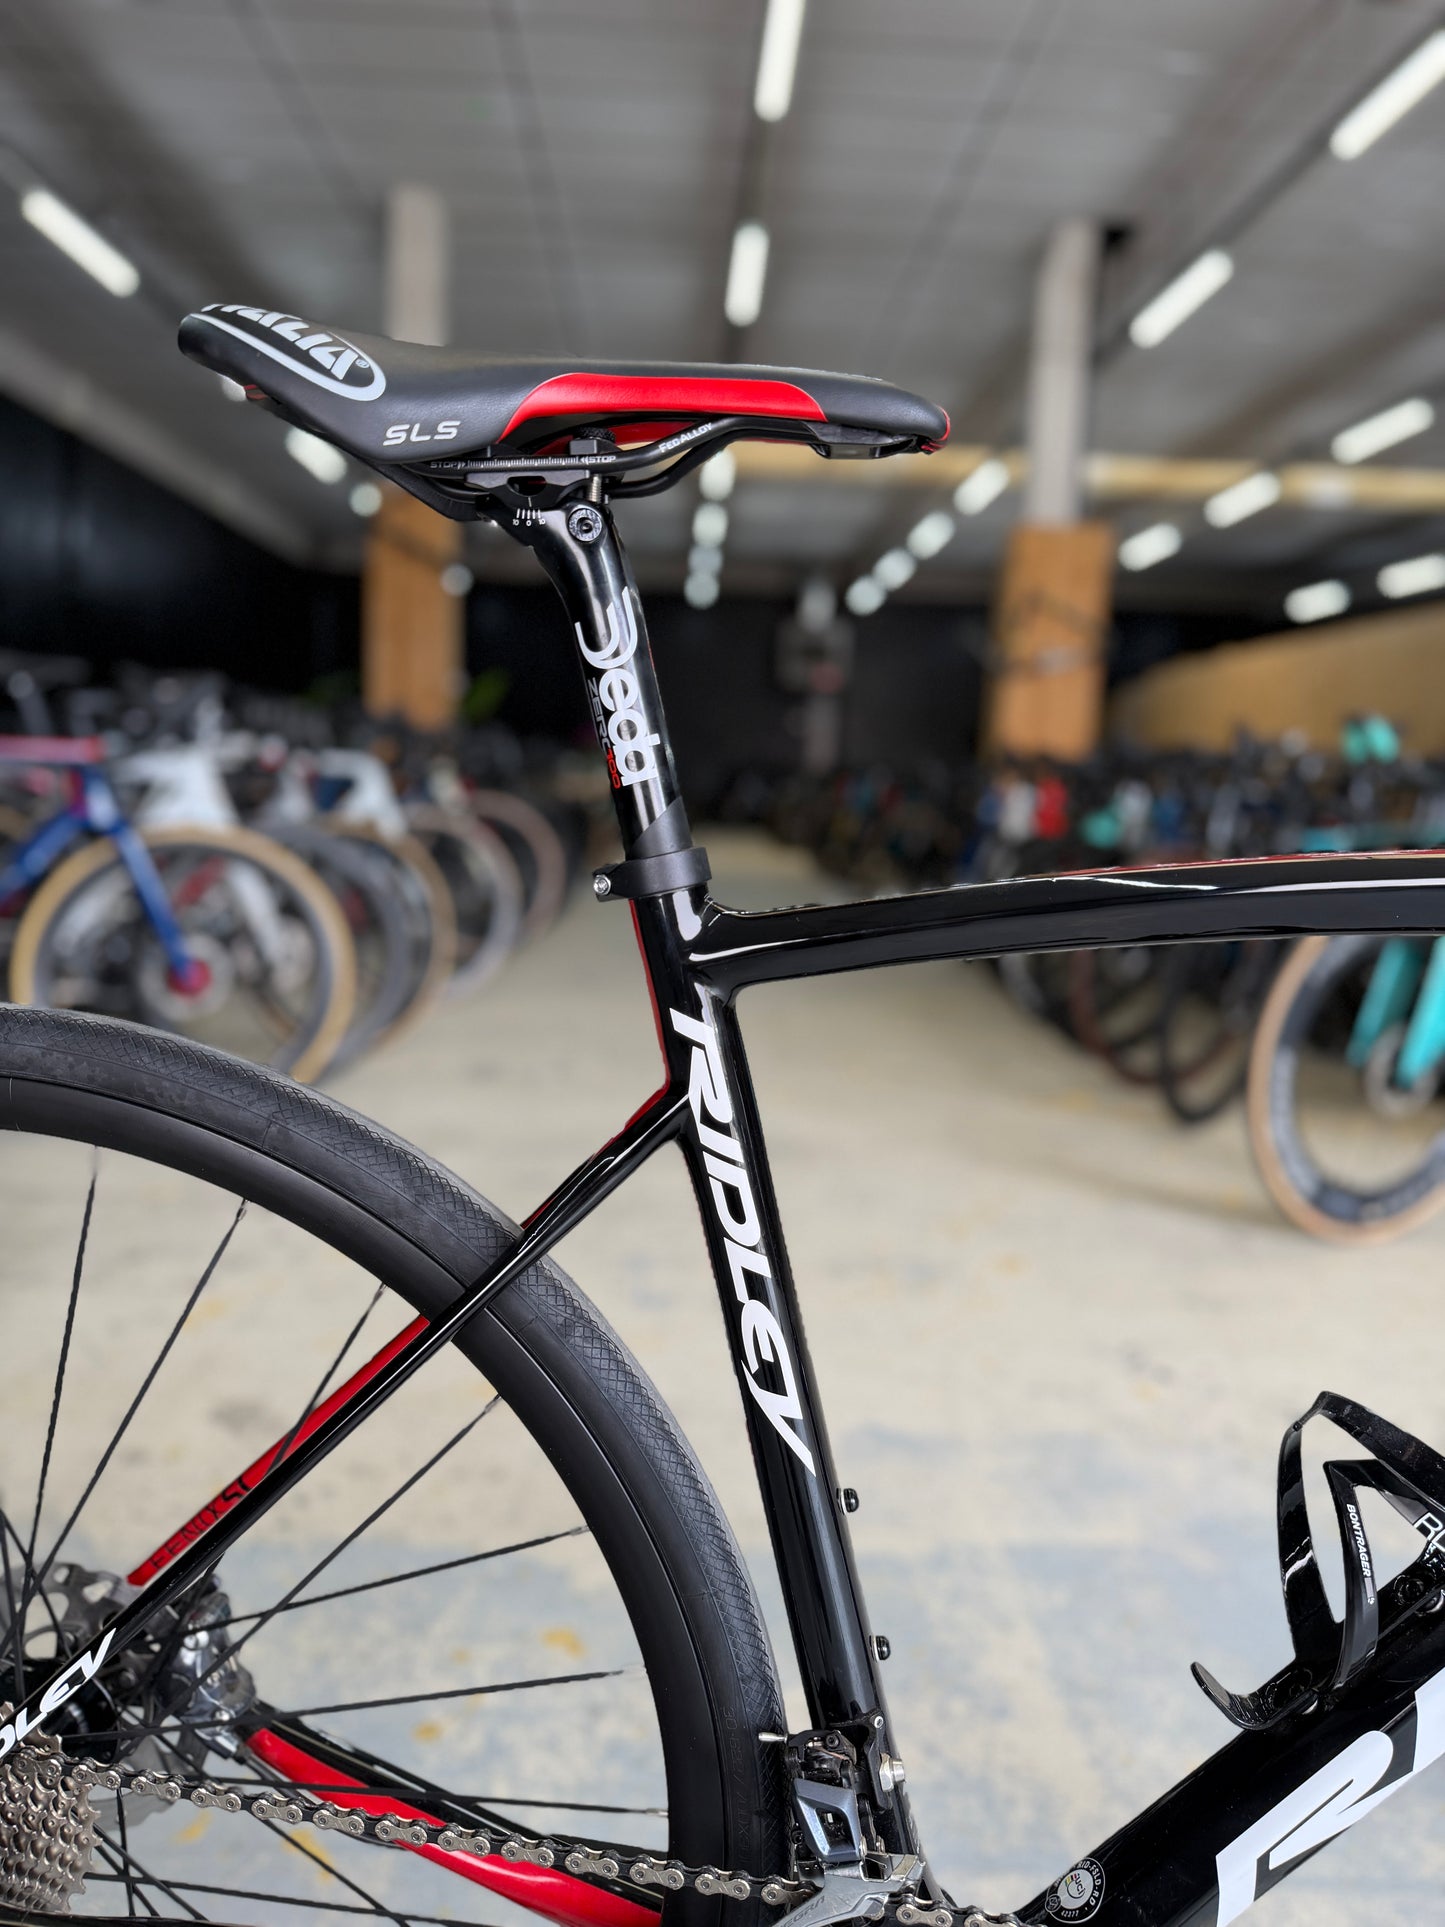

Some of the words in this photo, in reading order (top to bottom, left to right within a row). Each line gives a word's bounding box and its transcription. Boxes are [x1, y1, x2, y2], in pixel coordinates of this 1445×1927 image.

[383, 420, 461, 446] SLS
[587, 455, 616, 463] STOP
[670, 1007, 817, 1477] RIDLEY
[1346, 1503, 1372, 1578] BONTRAGER
